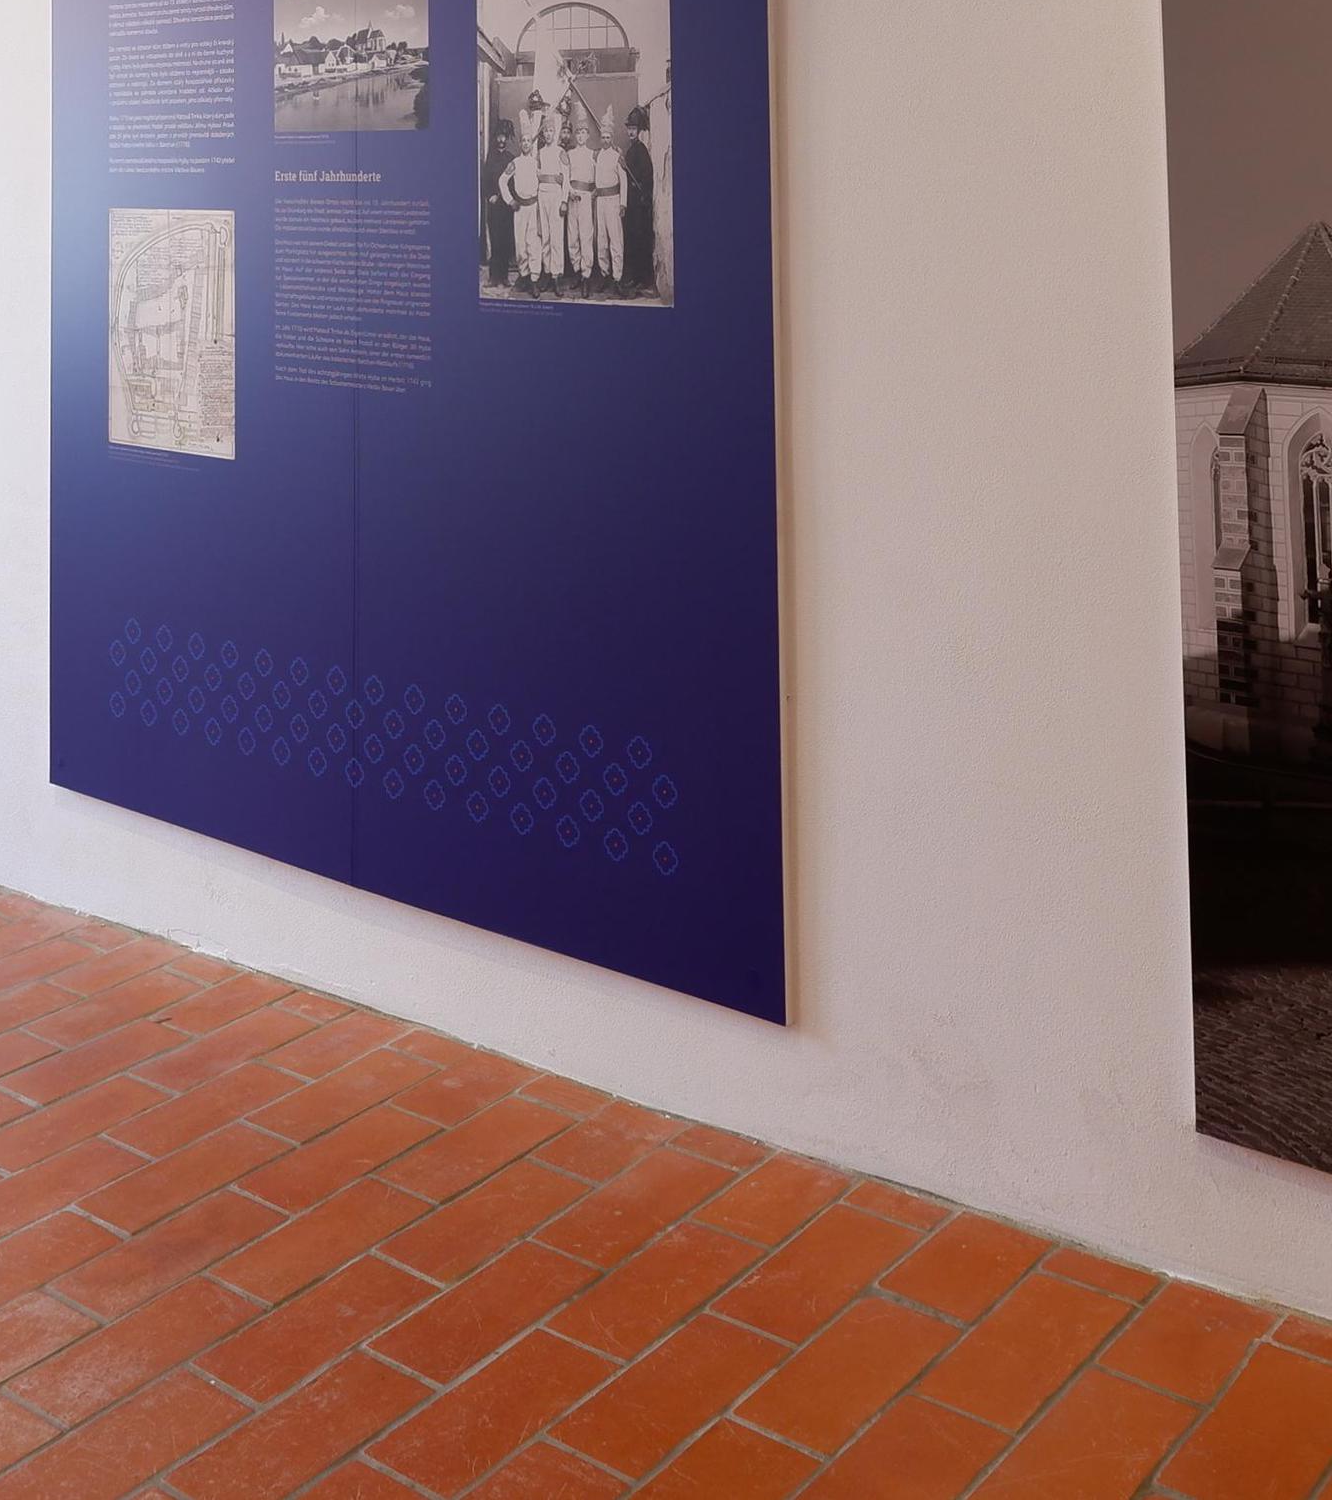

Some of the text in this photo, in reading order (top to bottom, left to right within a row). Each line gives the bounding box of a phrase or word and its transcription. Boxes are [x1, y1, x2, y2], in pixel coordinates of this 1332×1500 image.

[275, 169, 381, 182] Erste fünf Jahrhunderte
